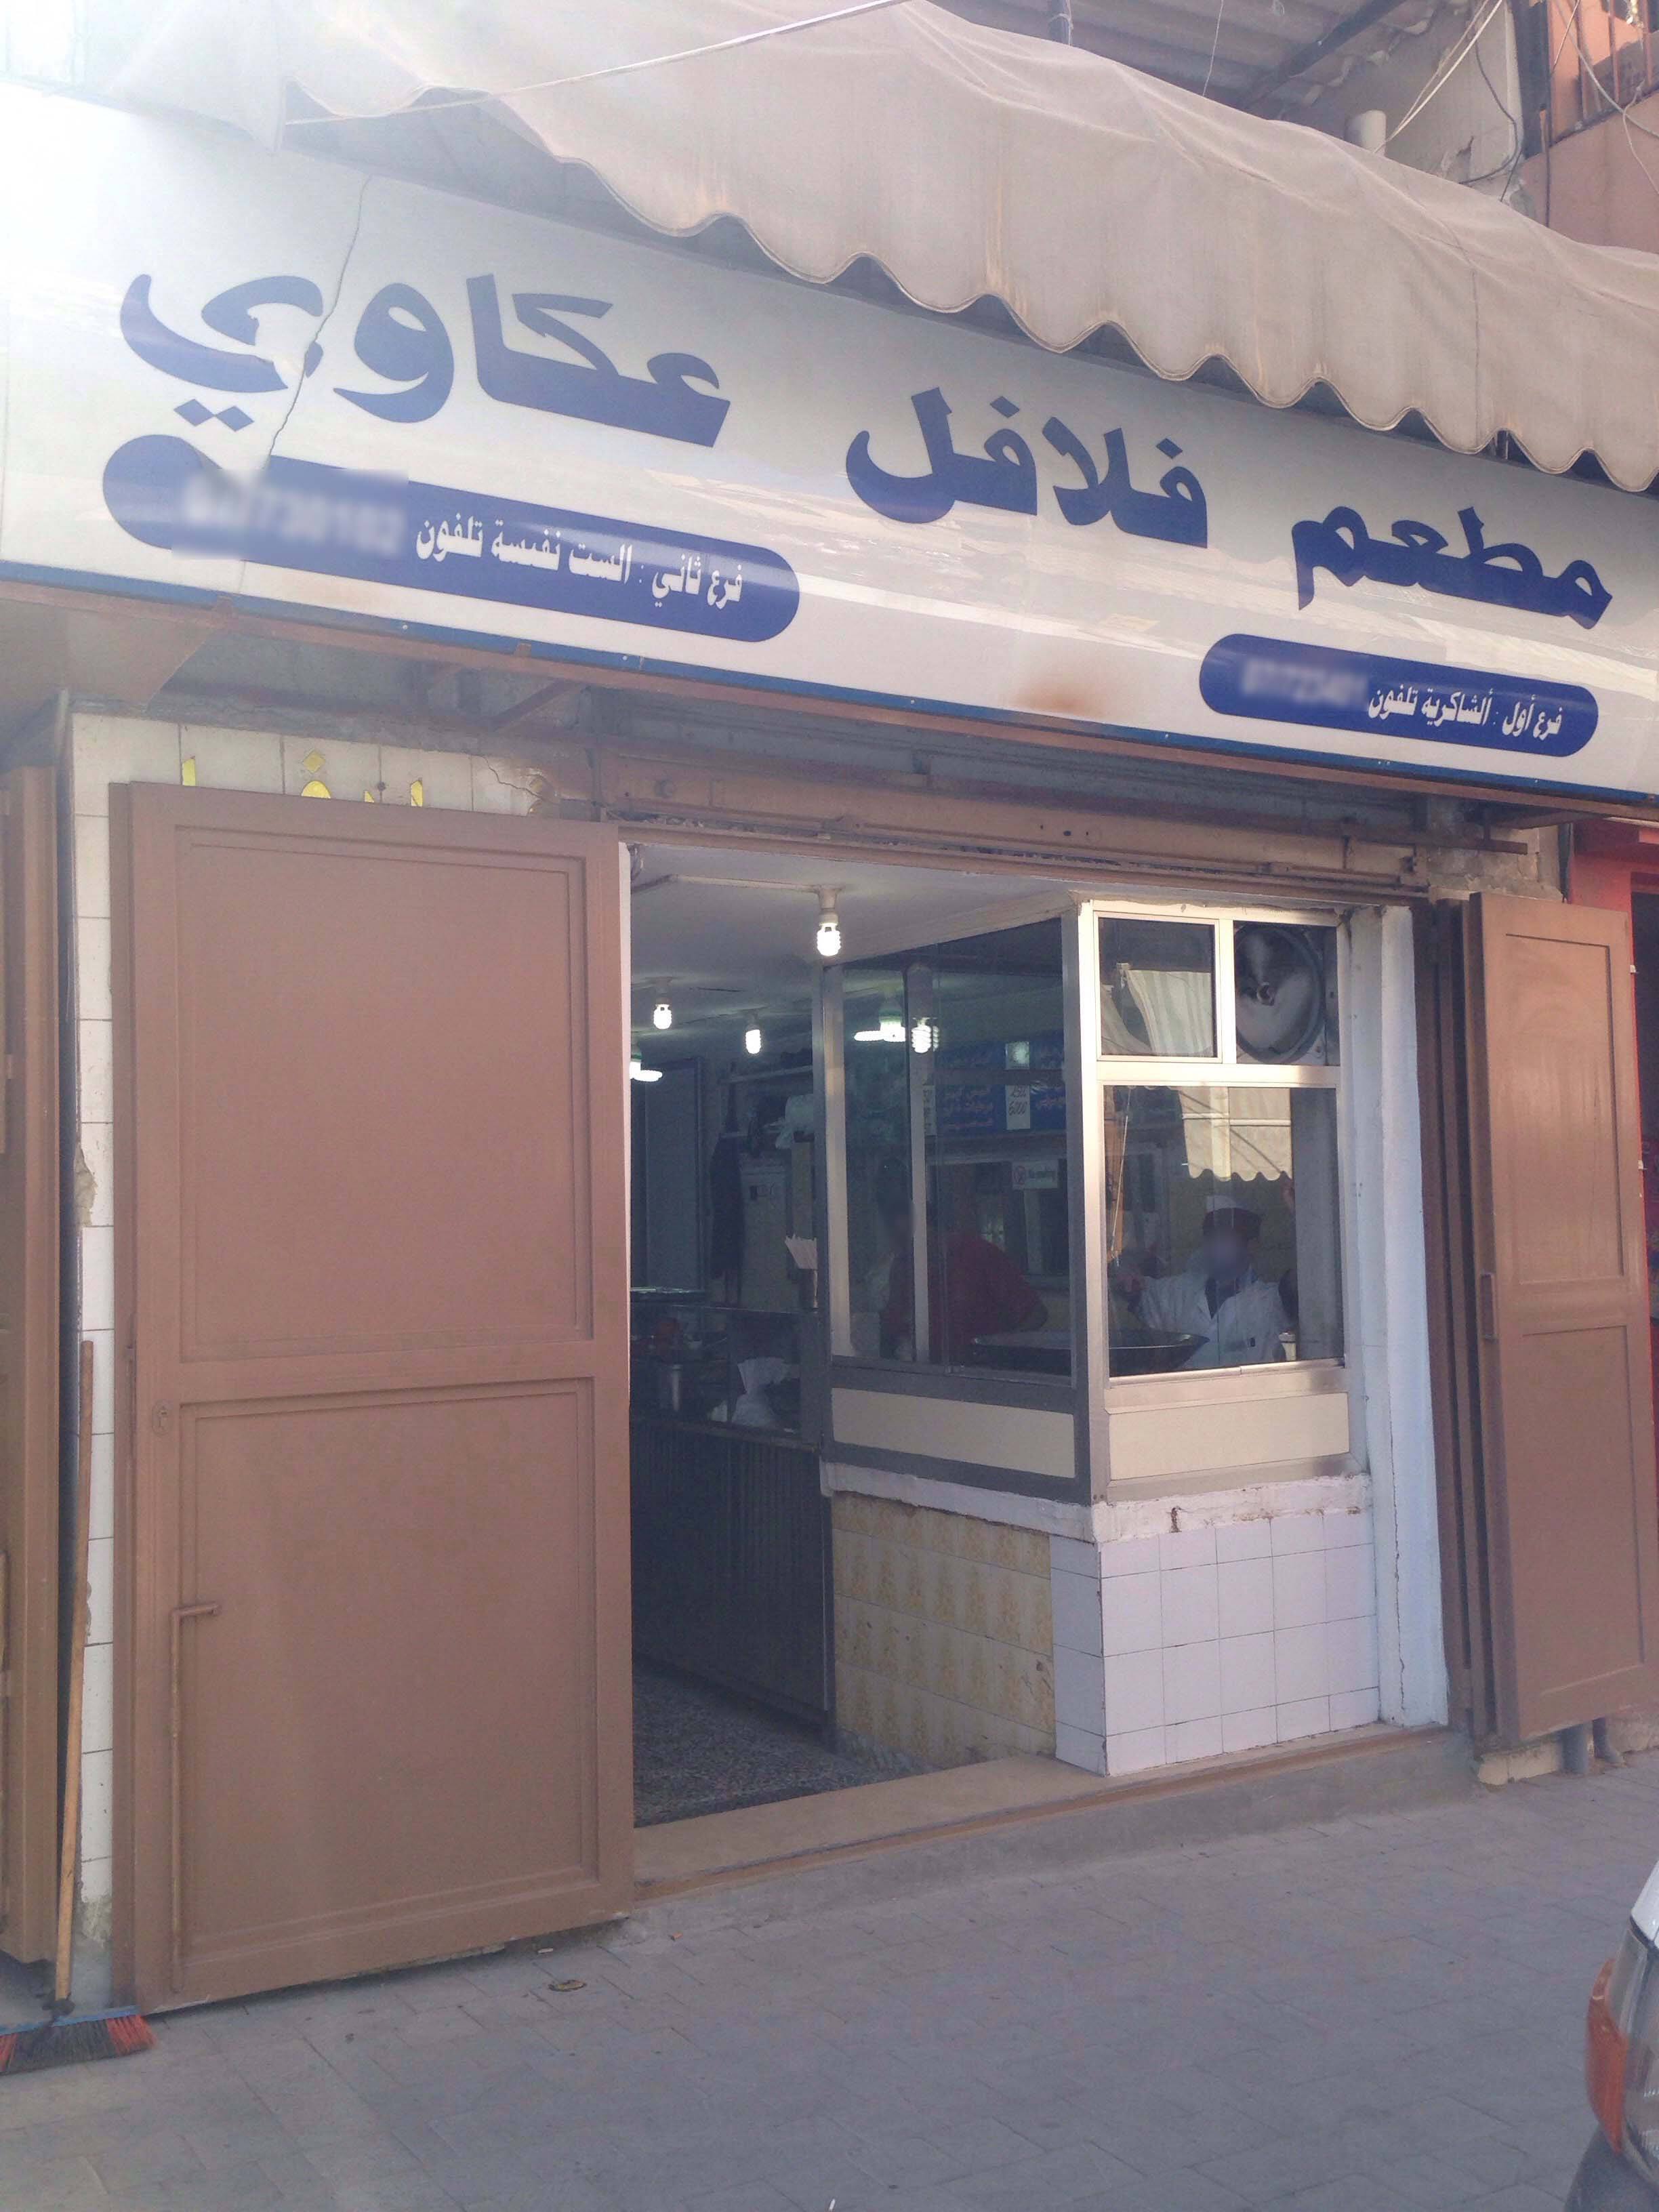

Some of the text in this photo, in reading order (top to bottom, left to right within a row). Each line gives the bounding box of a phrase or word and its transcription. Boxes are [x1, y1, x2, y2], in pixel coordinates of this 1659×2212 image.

[119, 273, 1613, 630] مطعم فلافل عكاوي
[415, 512, 483, 562] تلفون
[569, 542, 633, 585] الست
[652, 552, 701, 607] ثاني
[707, 564, 743, 609] فرع
[1368, 683, 1419, 720] تلفون
[1502, 694, 1536, 737] أول
[1532, 708, 1563, 741] فرع
